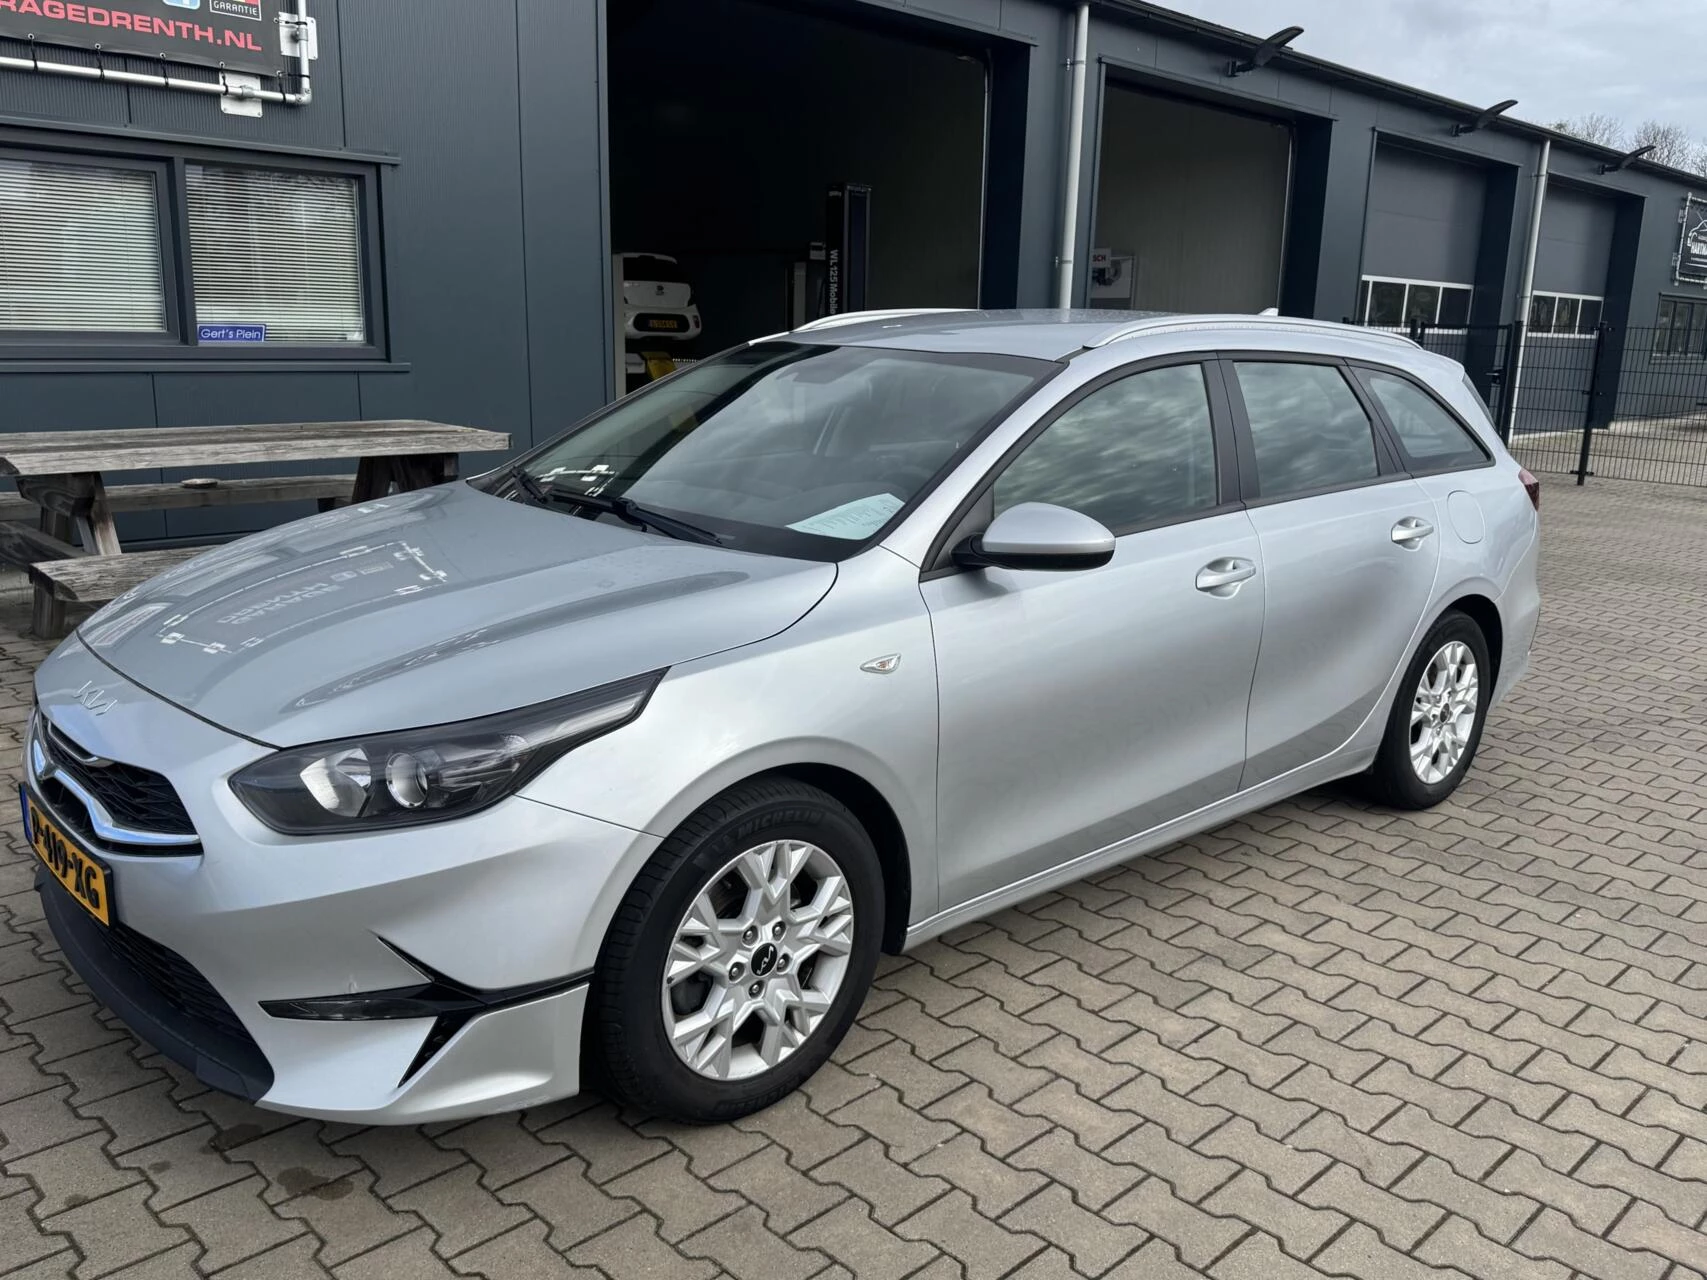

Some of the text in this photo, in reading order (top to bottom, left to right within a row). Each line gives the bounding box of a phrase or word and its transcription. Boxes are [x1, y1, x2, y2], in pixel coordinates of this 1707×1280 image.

[213, 2, 258, 15] GARANTIE
[829, 249, 839, 266] WL
[829, 266, 839, 282] 125
[200, 328, 261, 339] Gert's Plein
[737, 809, 823, 840] MICHELIN
[31, 806, 100, 909] P-419-XG
